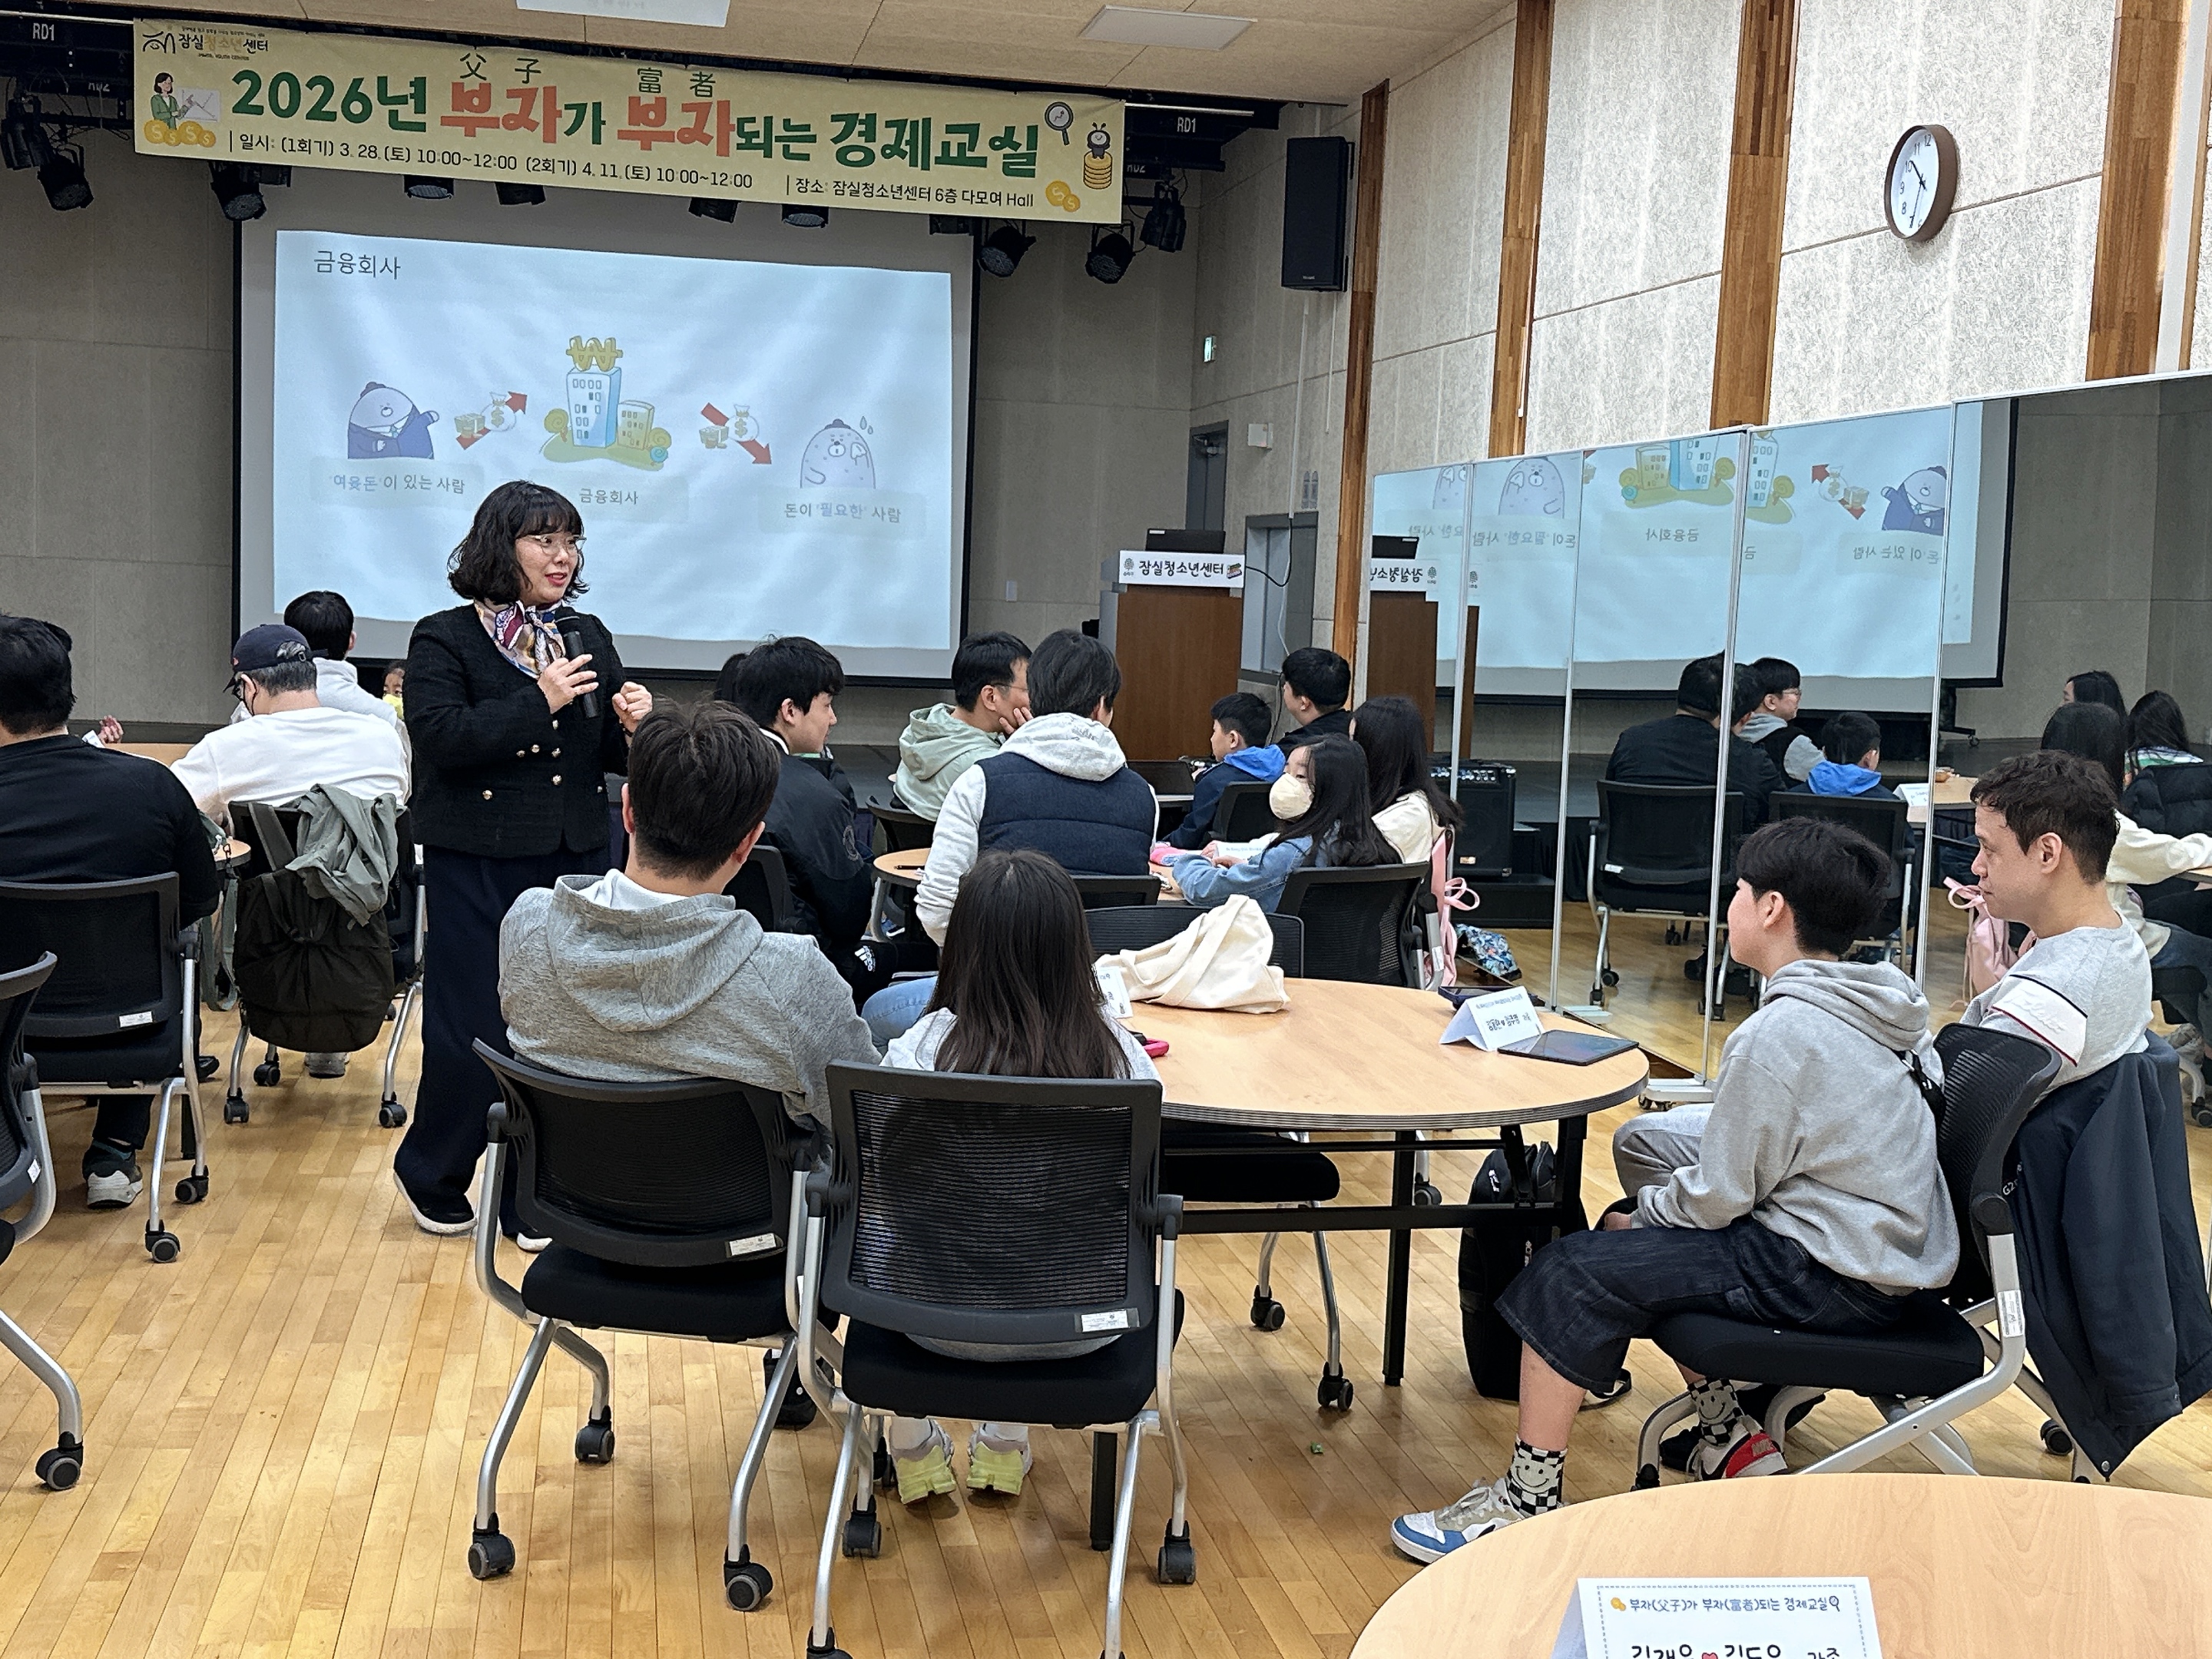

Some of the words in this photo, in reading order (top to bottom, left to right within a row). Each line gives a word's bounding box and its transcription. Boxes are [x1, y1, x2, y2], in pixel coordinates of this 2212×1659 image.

[32, 22, 55, 41] RD1
[231, 69, 427, 133] 2026년
[440, 82, 607, 145] 부자가
[617, 96, 818, 162] 부자되는
[830, 112, 1039, 179] 경제교실
[1177, 117, 1197, 134] RD1
[1924, 134, 1932, 147] 12
[240, 134, 275, 152] 일시:
[281, 137, 334, 157] (1회기)
[417, 149, 517, 171] 10:00~12:00
[526, 157, 577, 176] (2회기)
[656, 167, 753, 189] 10:00~12:00
[795, 178, 829, 193] 장소:
[833, 180, 932, 203] 잠실청소년센터
[935, 189, 957, 204] 6층
[961, 190, 1002, 207] 다모여
[1006, 193, 1034, 207] Hall
[1899, 181, 1905, 195] 9
[1901, 201, 1907, 215] 8
[313, 250, 401, 280] 금융회사
[403, 474, 433, 491] 있는
[436, 477, 465, 495] 사람
[579, 488, 639, 505] 금융회사
[784, 502, 813, 518] 돈이
[871, 506, 902, 524] 사람
[1138, 559, 1224, 578] 잠실청소년센터
[1630, 1598, 1698, 1612] 부자(父子)가
[1702, 1598, 1780, 1611] 부자(富者)되는
[1784, 1597, 1828, 1611] 경제교실
